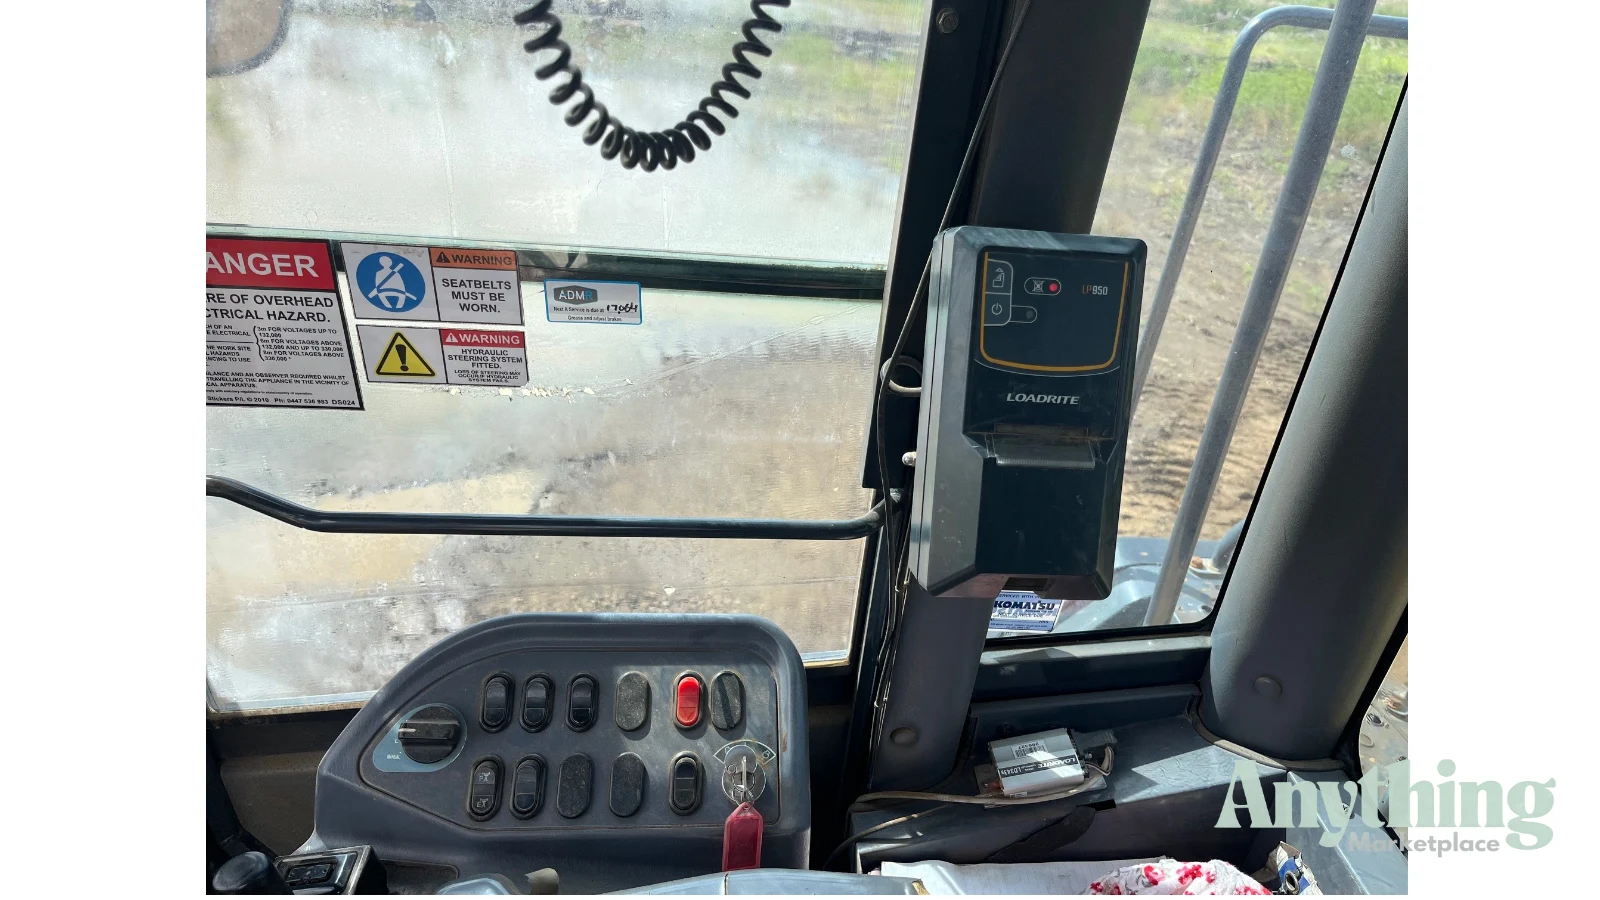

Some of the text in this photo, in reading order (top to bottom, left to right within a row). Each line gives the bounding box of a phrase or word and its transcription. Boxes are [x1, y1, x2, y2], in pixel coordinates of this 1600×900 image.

[452, 254, 512, 266] WARNING
[442, 278, 512, 290] SEATBELTS
[451, 291, 505, 302] MUST BE
[559, 290, 593, 300] ADMR
[230, 294, 249, 304] OF
[253, 294, 334, 308] OVERHEAD
[459, 303, 501, 313] WORN.
[266, 310, 331, 322] HAZARD.
[459, 333, 520, 345] WARNING
[461, 348, 509, 356] HYDRAULIC
[448, 354, 489, 362] STEERING
[1006, 392, 1080, 405] LOADRITE
[993, 600, 1056, 610] KOMATSU
